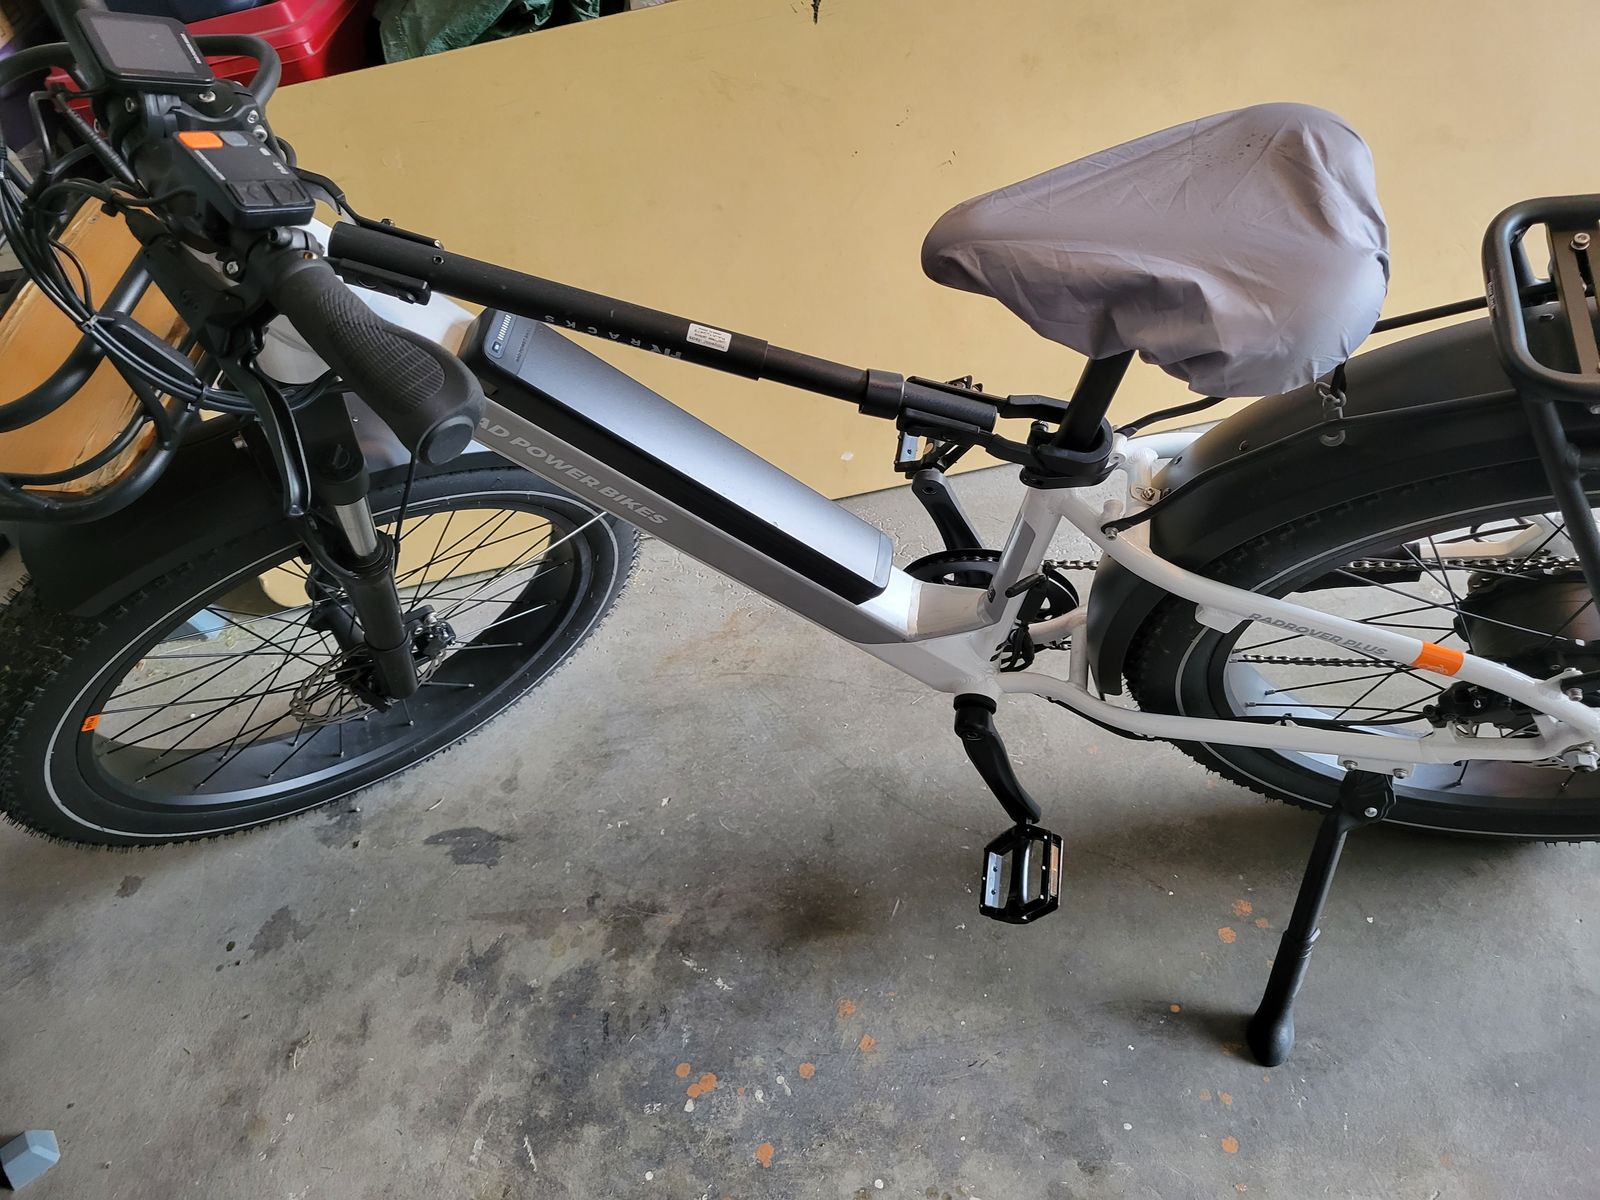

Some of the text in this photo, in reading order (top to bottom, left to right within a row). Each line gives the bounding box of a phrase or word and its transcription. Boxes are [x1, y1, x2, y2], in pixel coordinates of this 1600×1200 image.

[479, 417, 669, 525] AD POWER BIKES
[1249, 612, 1388, 656] RADROVER PLUS
